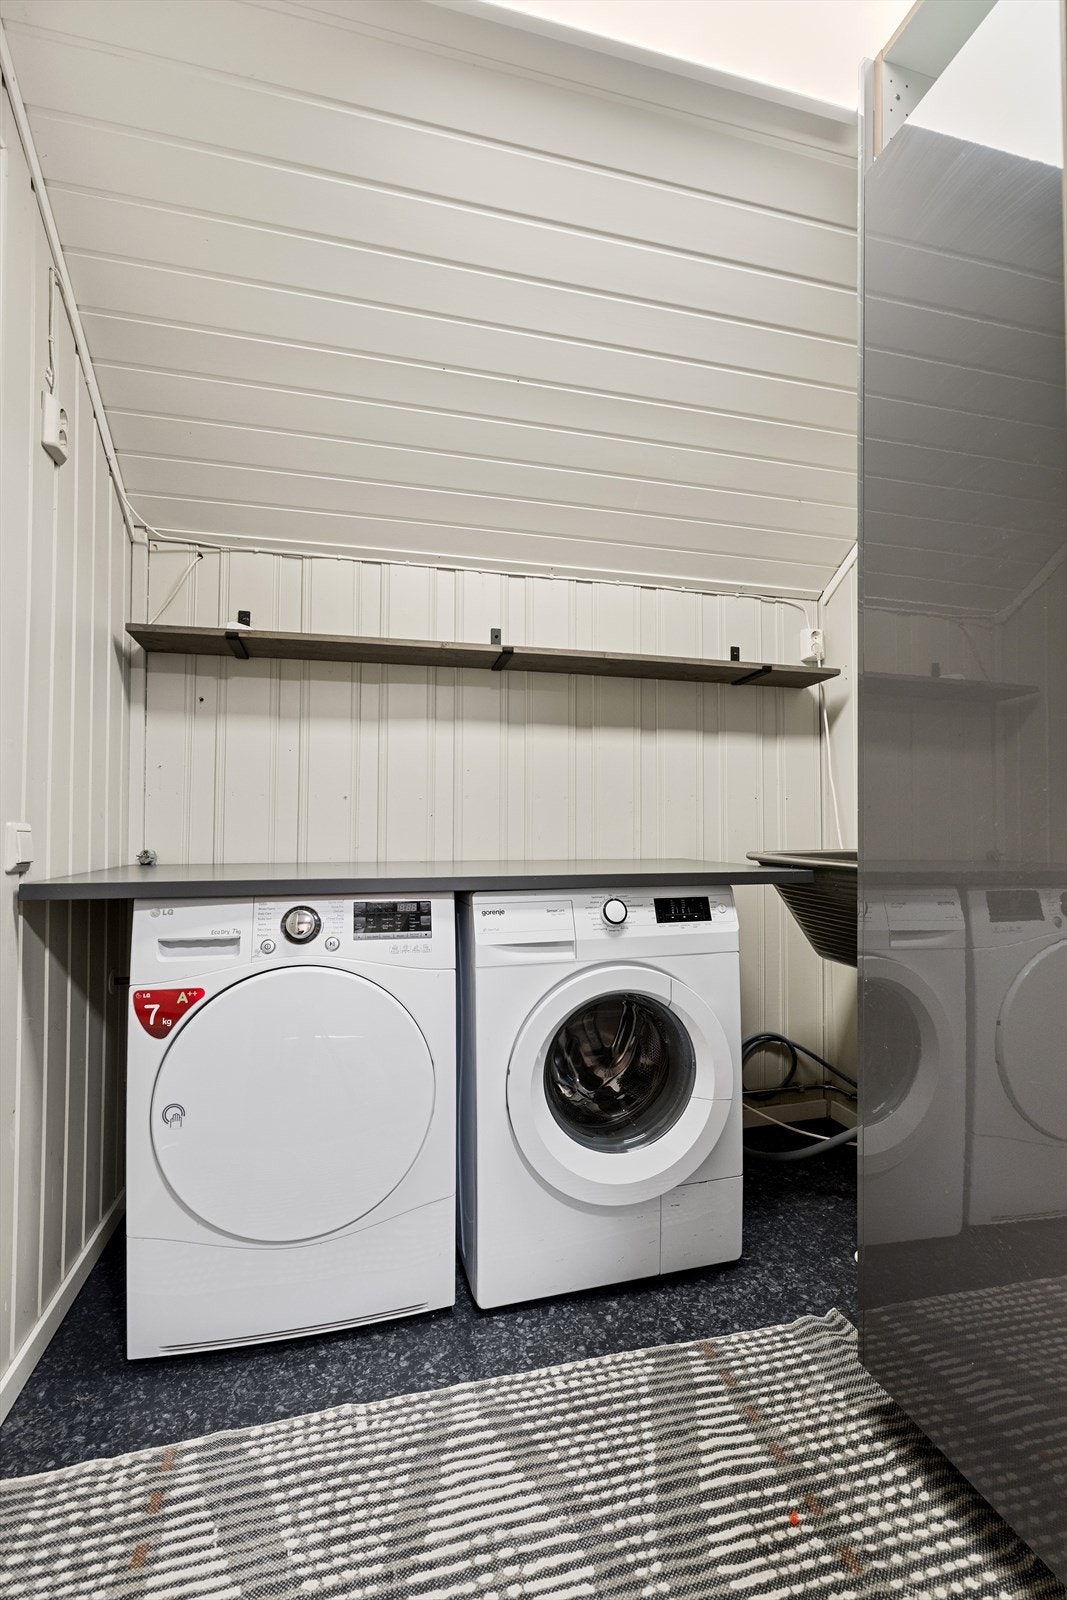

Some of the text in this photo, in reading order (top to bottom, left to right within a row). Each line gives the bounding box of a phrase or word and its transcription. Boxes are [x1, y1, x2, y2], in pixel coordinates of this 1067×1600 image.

[177, 991, 198, 1004] A++
[144, 1004, 172, 1027] 7 kg
